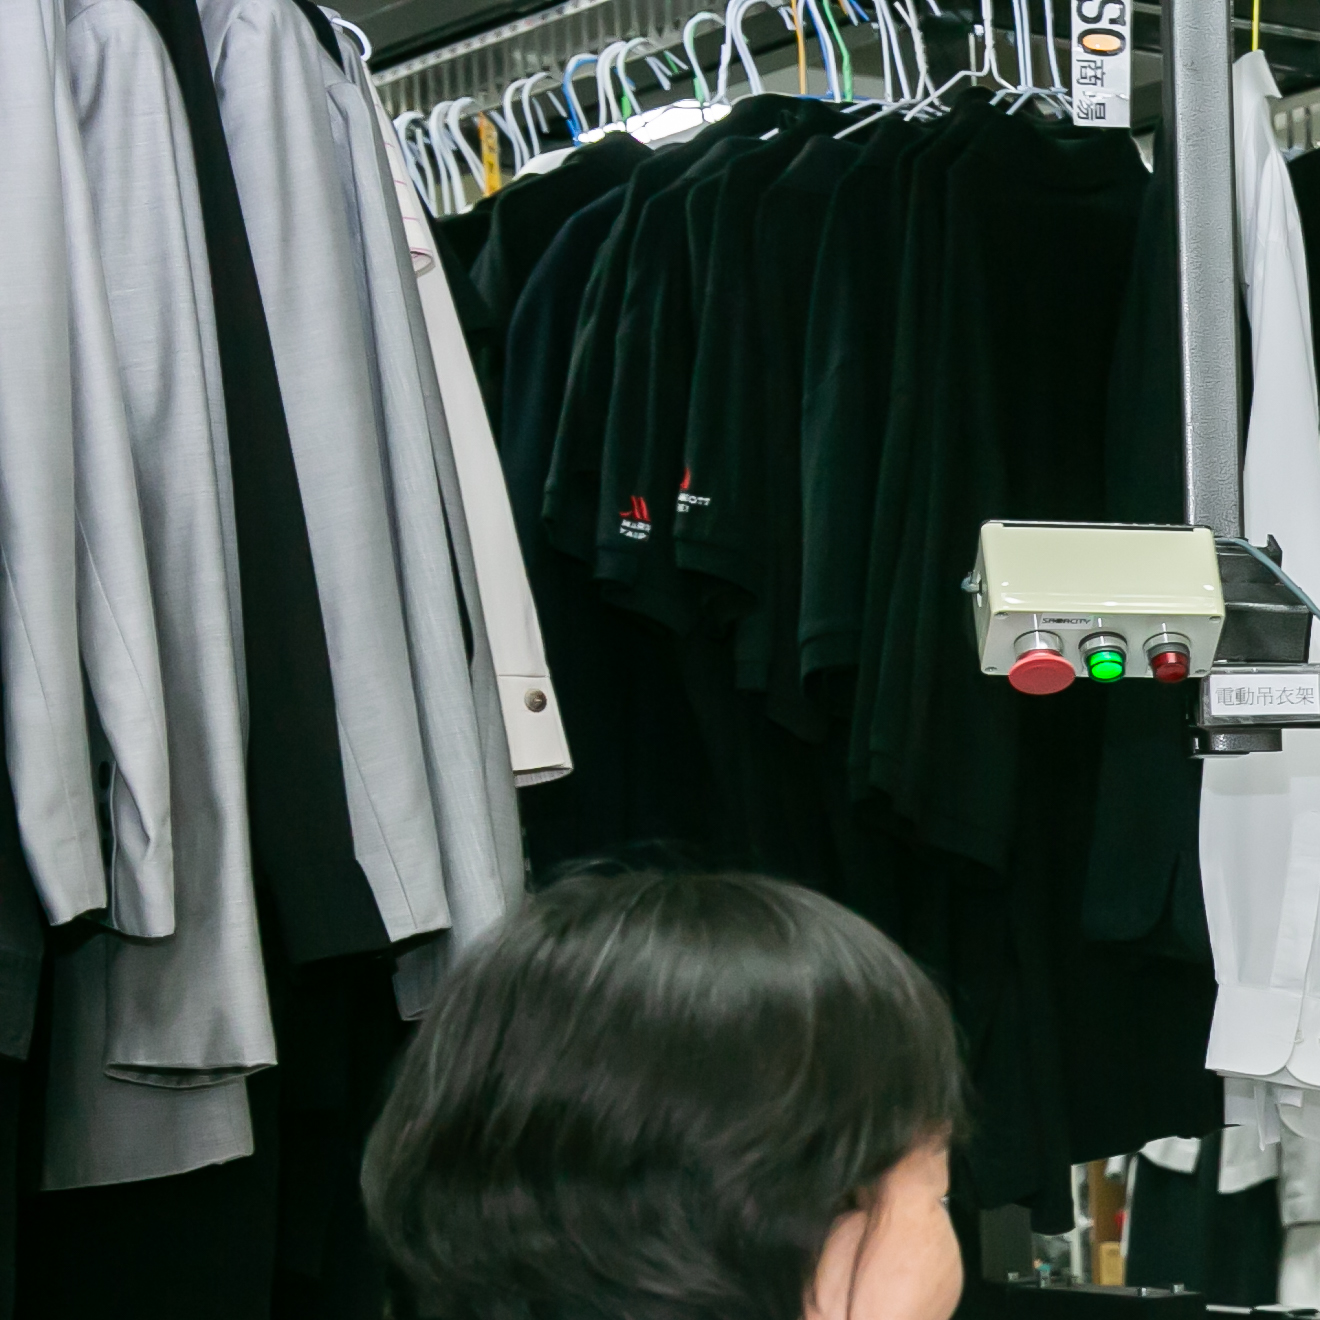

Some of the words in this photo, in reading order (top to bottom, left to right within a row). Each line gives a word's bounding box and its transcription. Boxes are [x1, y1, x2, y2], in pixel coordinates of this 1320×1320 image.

[1215, 686, 1315, 706] 電動吊衣架
